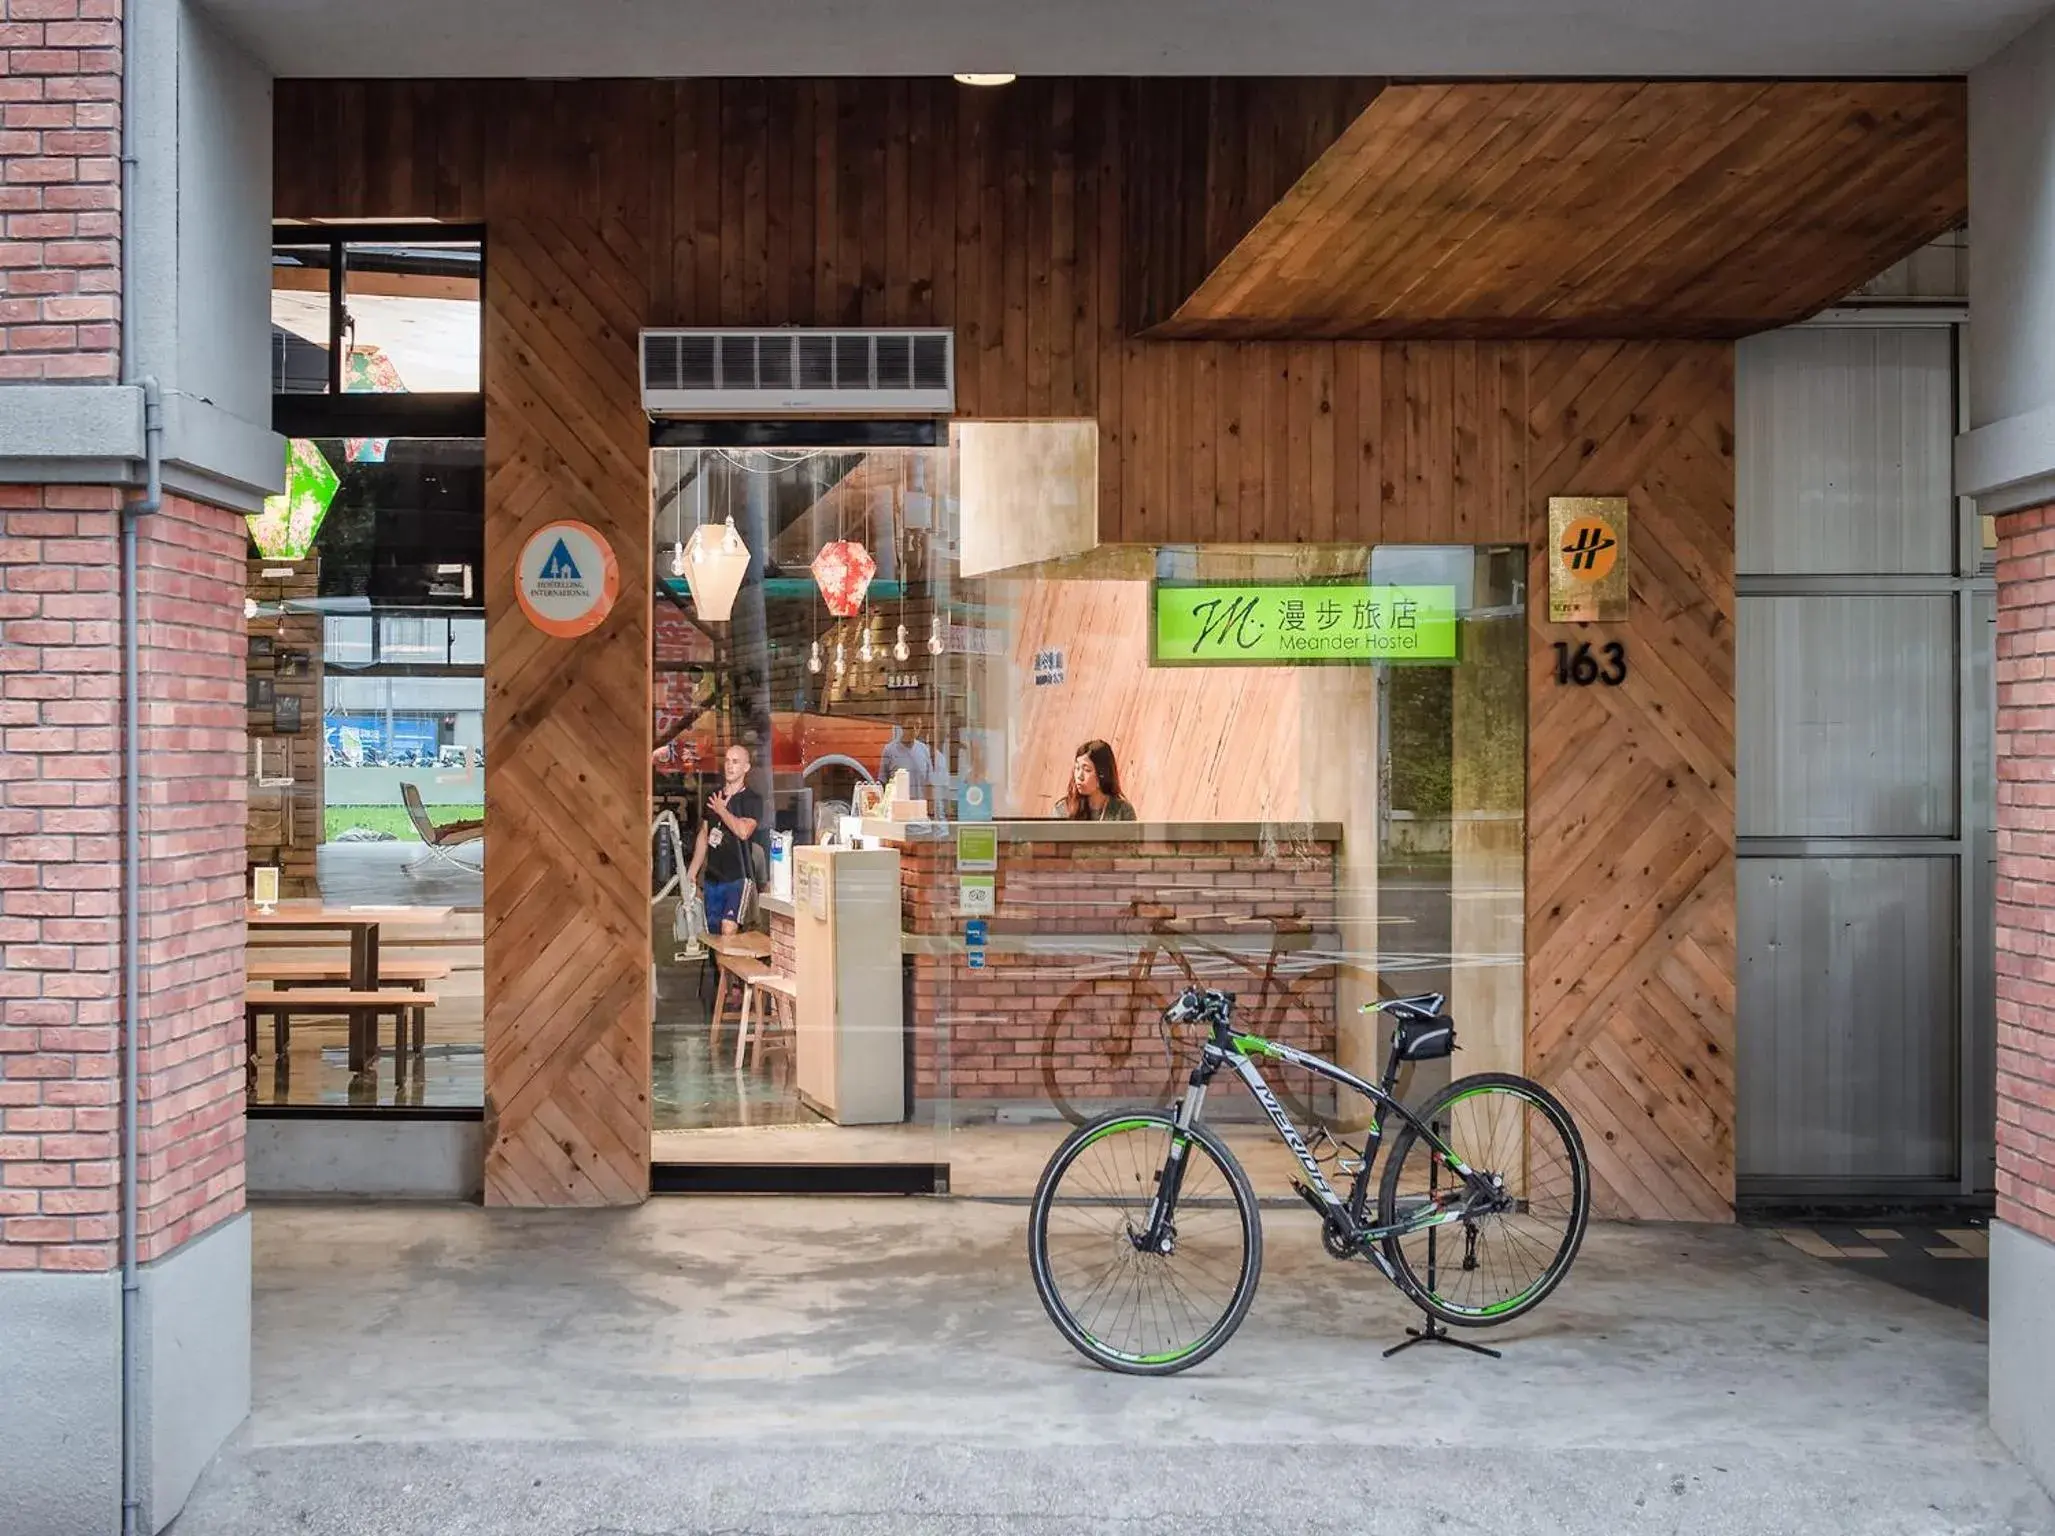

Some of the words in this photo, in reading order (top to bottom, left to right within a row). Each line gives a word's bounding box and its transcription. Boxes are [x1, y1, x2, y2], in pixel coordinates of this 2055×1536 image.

[531, 589, 590, 597] INTERNATIONAL
[1278, 600, 1418, 630] 漫步旅店
[1279, 635, 1359, 650] Meander
[1365, 632, 1419, 649] Hostel
[1553, 641, 1627, 686] 163
[1255, 1084, 1333, 1194] MERIDA
